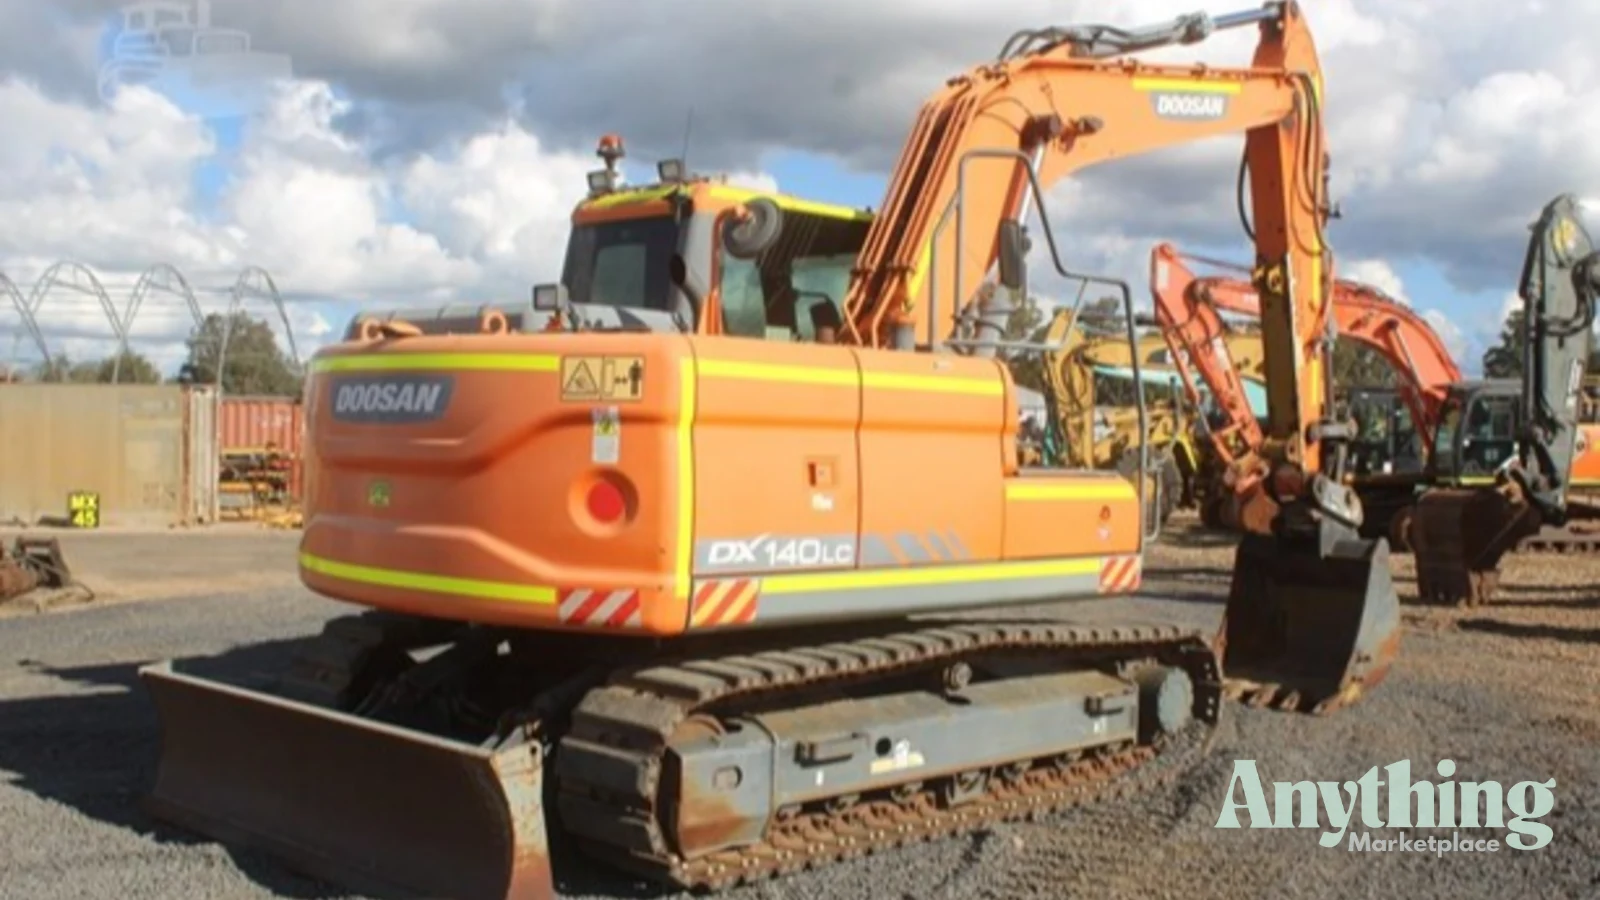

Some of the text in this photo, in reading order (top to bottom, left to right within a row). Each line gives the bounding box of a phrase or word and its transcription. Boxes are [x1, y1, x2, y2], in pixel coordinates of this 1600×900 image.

[1157, 94, 1224, 117] DOOSAN
[335, 382, 441, 413] DOOSAN
[72, 510, 96, 527] 45
